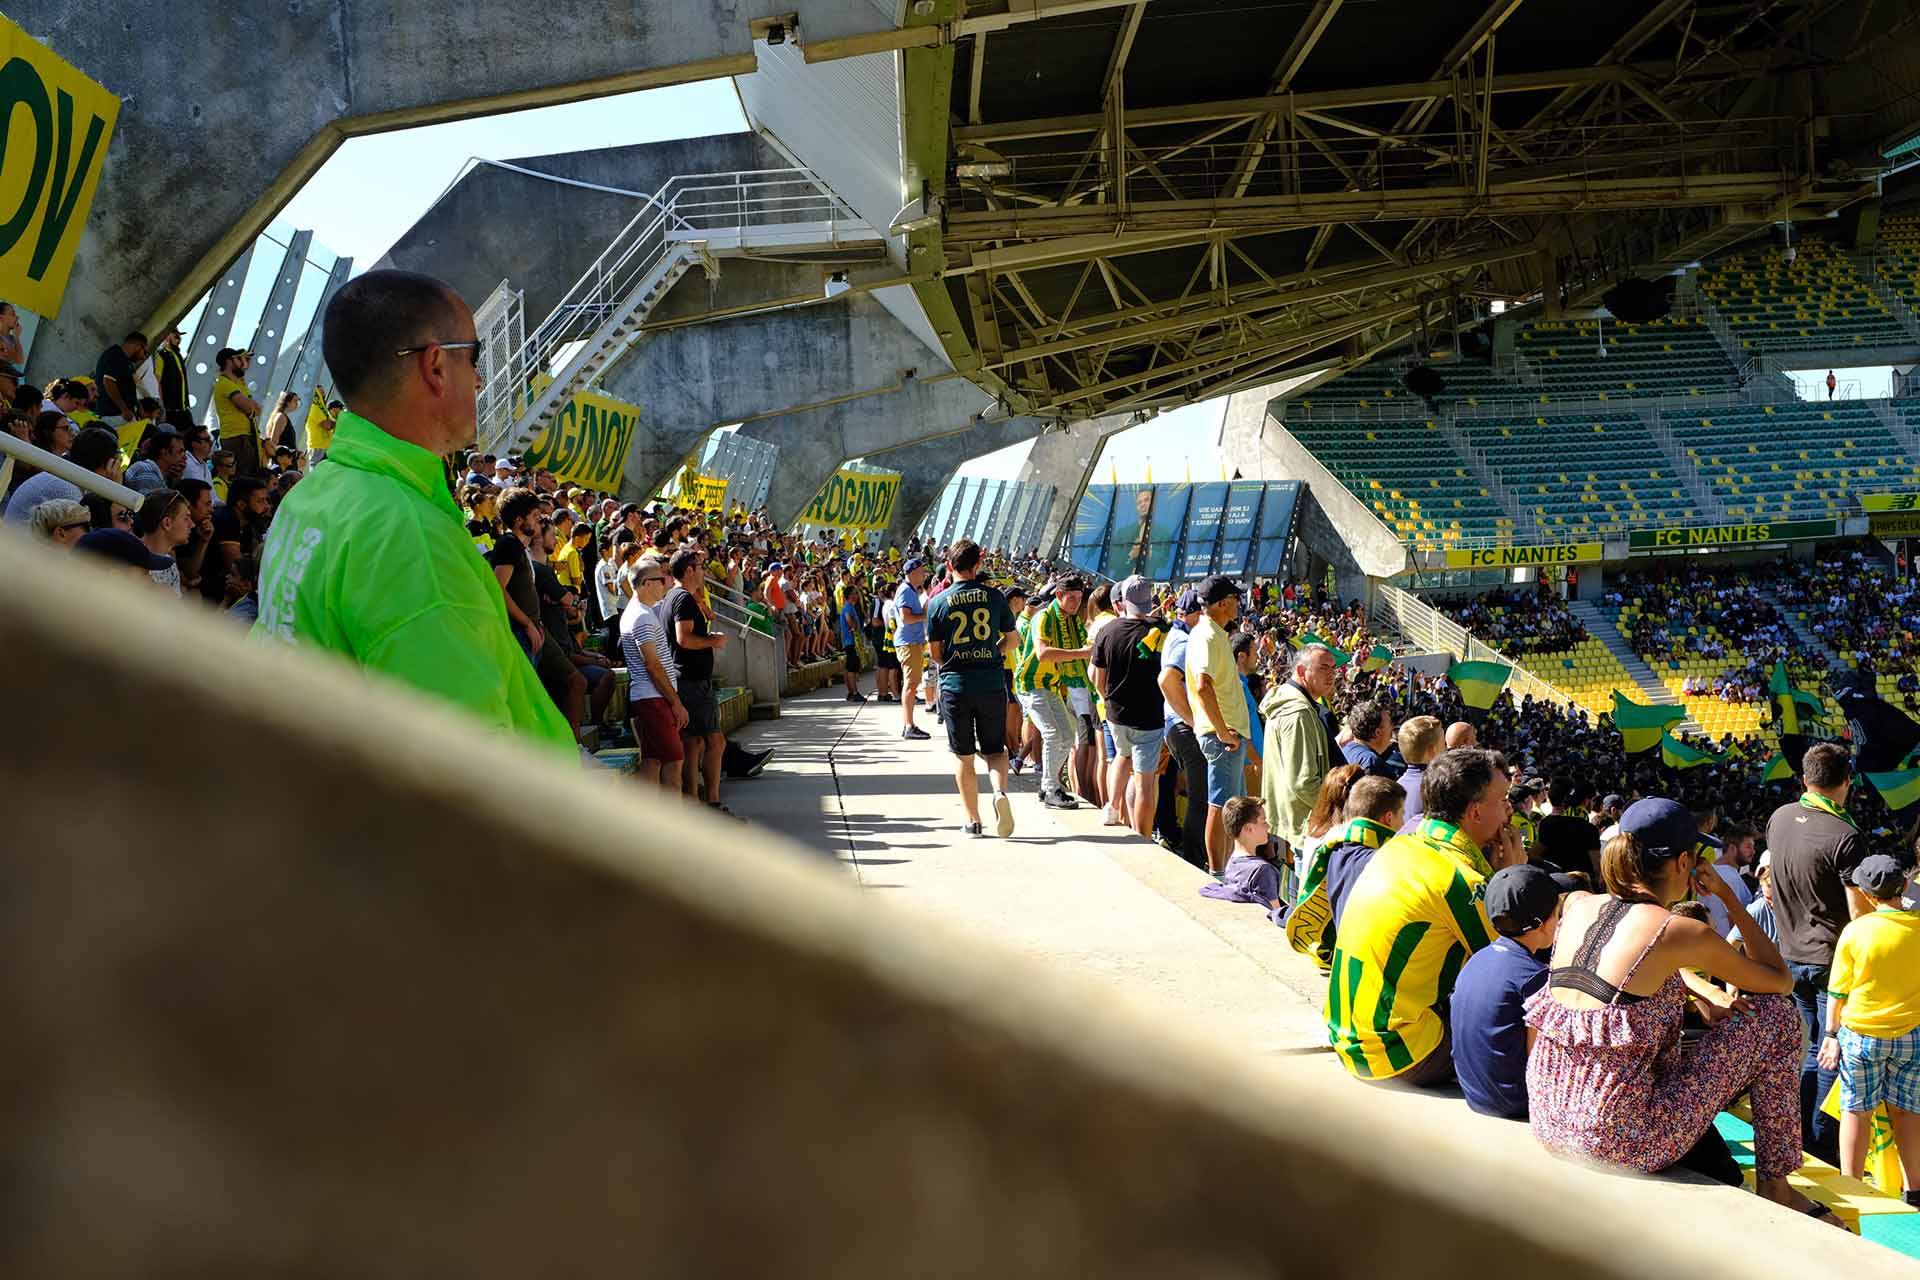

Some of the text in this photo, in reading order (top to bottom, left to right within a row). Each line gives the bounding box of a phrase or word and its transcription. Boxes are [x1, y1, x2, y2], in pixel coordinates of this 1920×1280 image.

[1655, 524, 1770, 545] FC NANTES
[1471, 545, 1578, 565] FC NANTES
[948, 607, 991, 645] 28
